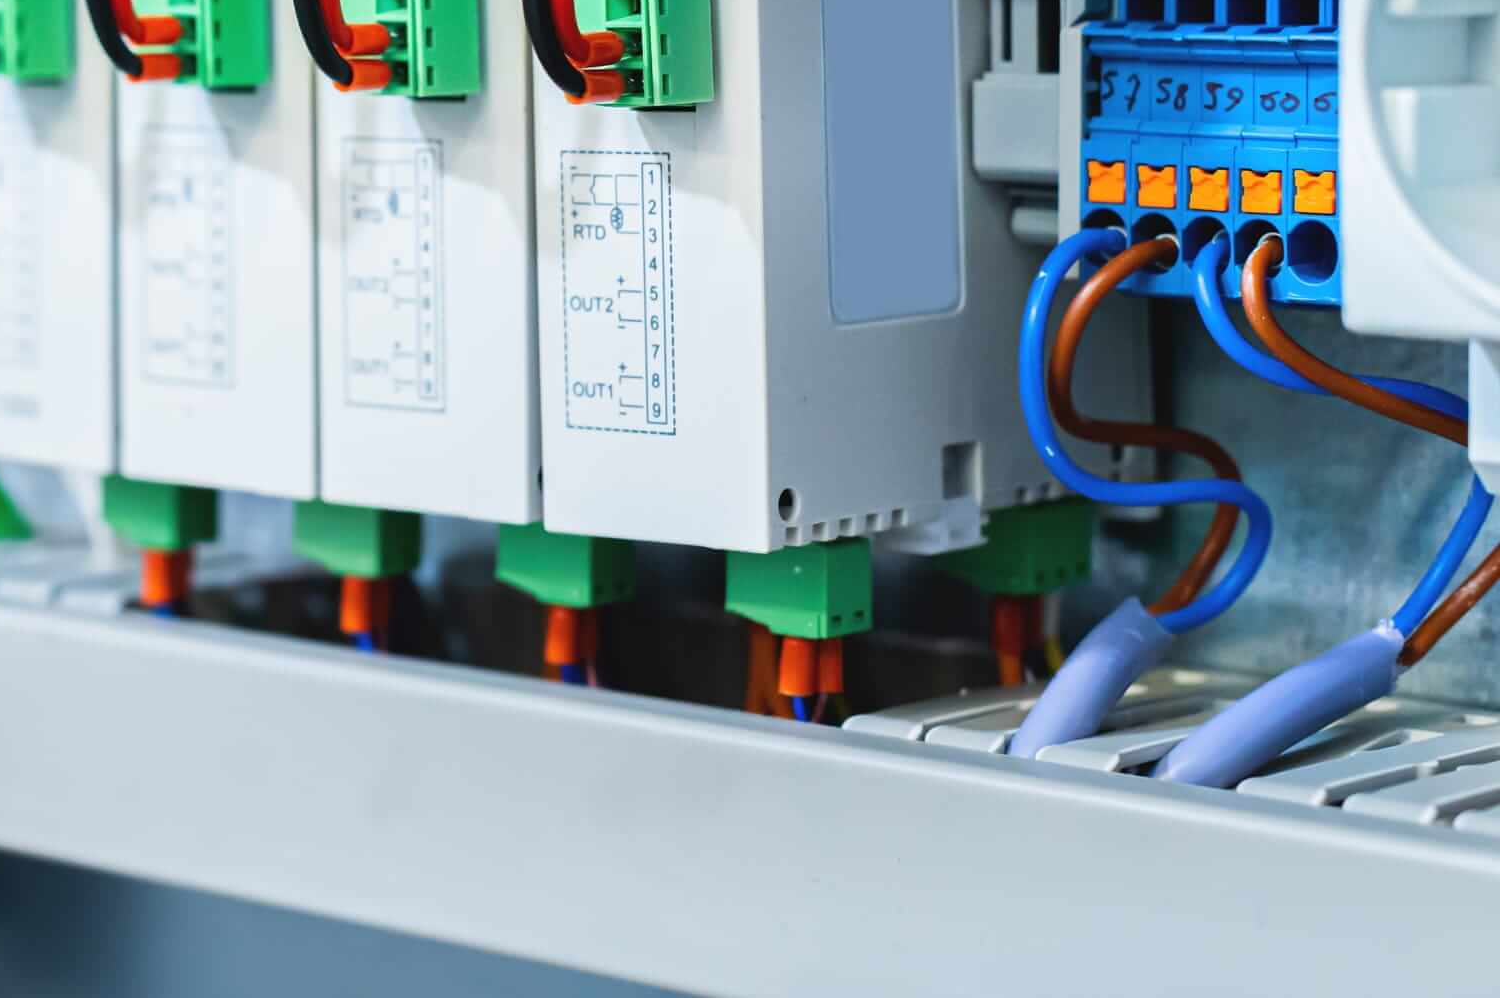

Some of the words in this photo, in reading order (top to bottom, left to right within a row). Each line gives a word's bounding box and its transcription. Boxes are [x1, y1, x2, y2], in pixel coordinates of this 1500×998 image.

[1101, 70, 1141, 113] 57
[1156, 77, 1189, 112] 58
[1203, 81, 1245, 112] 59
[1312, 90, 1338, 114] 6
[647, 170, 655, 184] 1
[648, 200, 657, 215] 2
[572, 224, 606, 241] RTD
[648, 228, 658, 243] 3
[648, 257, 658, 271] 4
[649, 286, 659, 301] 5
[569, 295, 614, 314] OUT2
[650, 315, 660, 330] 6
[651, 344, 660, 359] 7
[651, 373, 661, 388] 8
[572, 381, 614, 400] OUT1
[652, 402, 662, 418] 9
